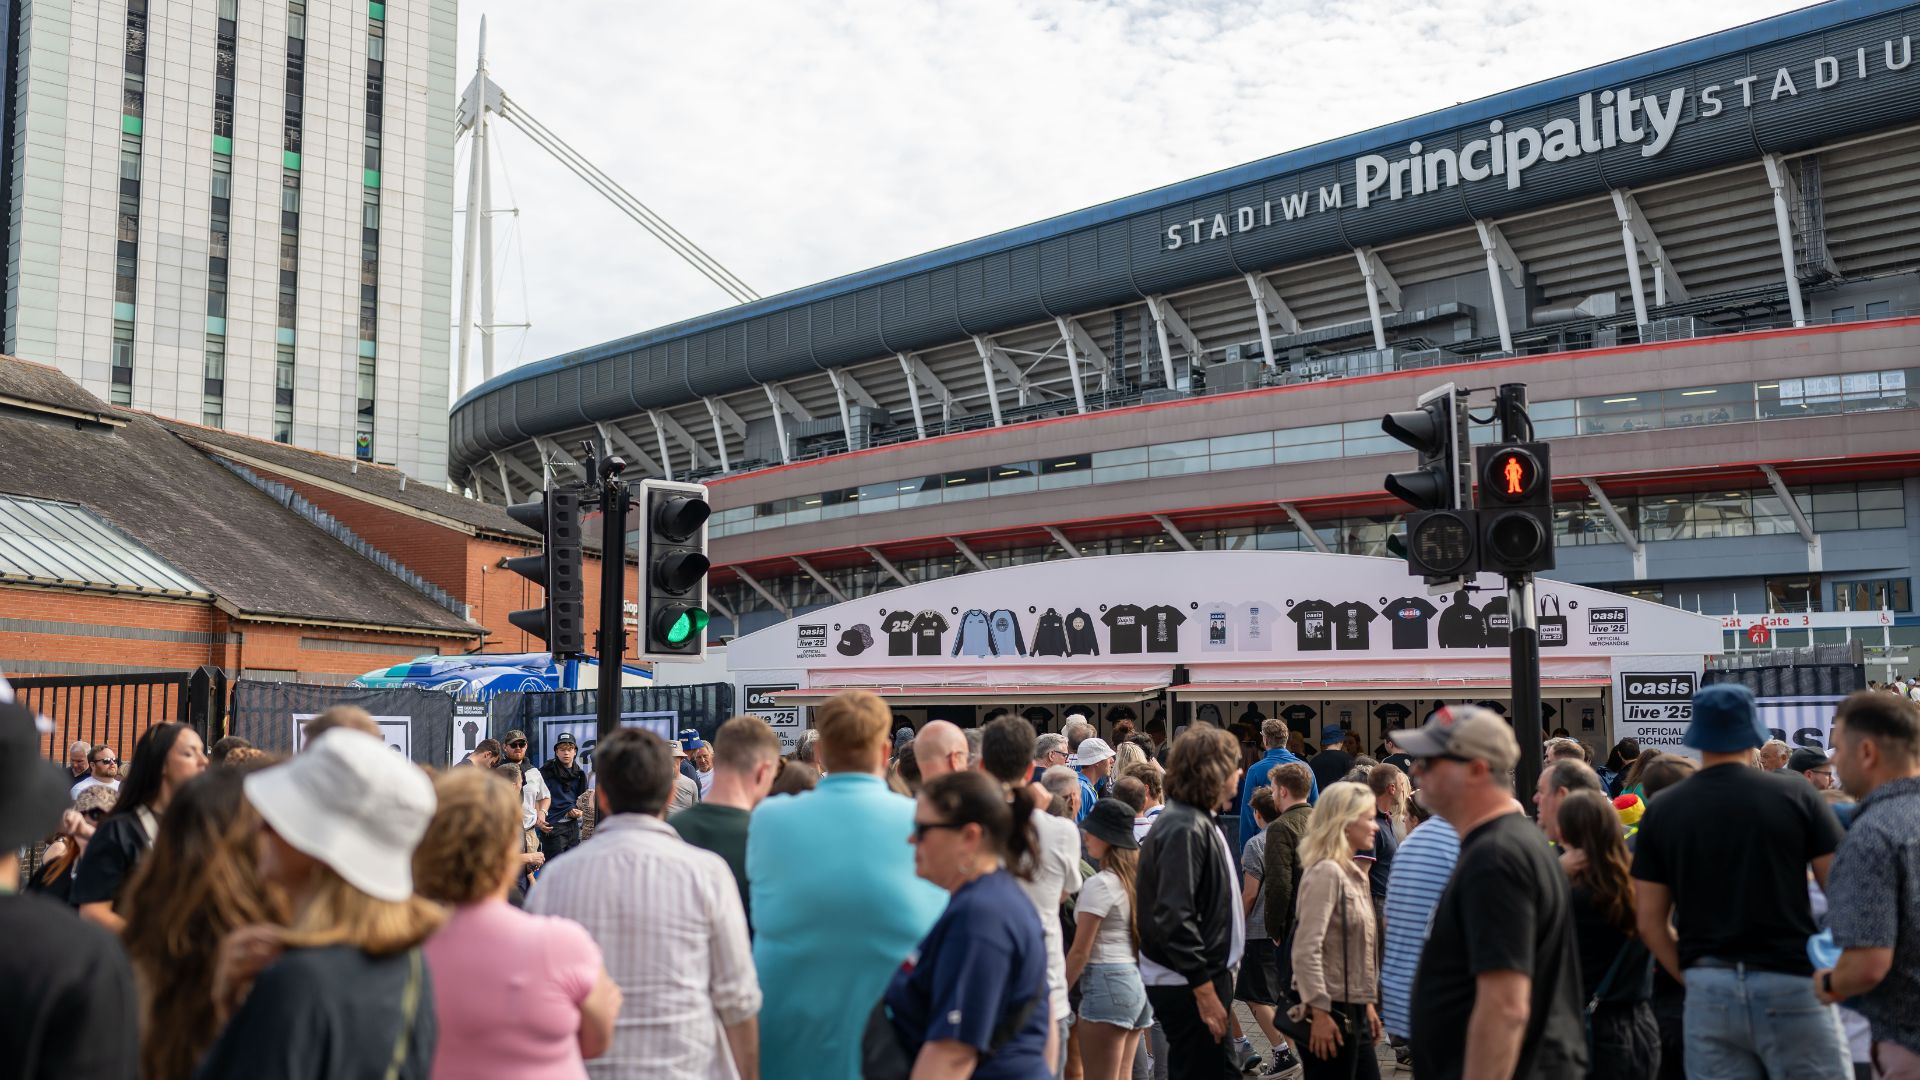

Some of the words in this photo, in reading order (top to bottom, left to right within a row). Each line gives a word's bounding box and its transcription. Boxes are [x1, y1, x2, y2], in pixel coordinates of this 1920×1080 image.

[1167, 183, 1342, 250] STADIWM
[1355, 87, 1685, 209] Principality
[1701, 35, 1912, 117] STADIU
[1592, 610, 1624, 620] oasis
[1761, 616, 1789, 626] Gate
[1802, 615, 1809, 625] 3
[800, 627, 824, 636] oasis
[891, 620, 910, 632] 25
[1592, 624, 1608, 632] live
[1610, 624, 1625, 632] '25
[1629, 679, 1690, 695] oasis
[1628, 705, 1660, 719] live
[1663, 705, 1692, 719] '25
[773, 712, 795, 724] '25
[1637, 727, 1685, 736] OFFICIAL
